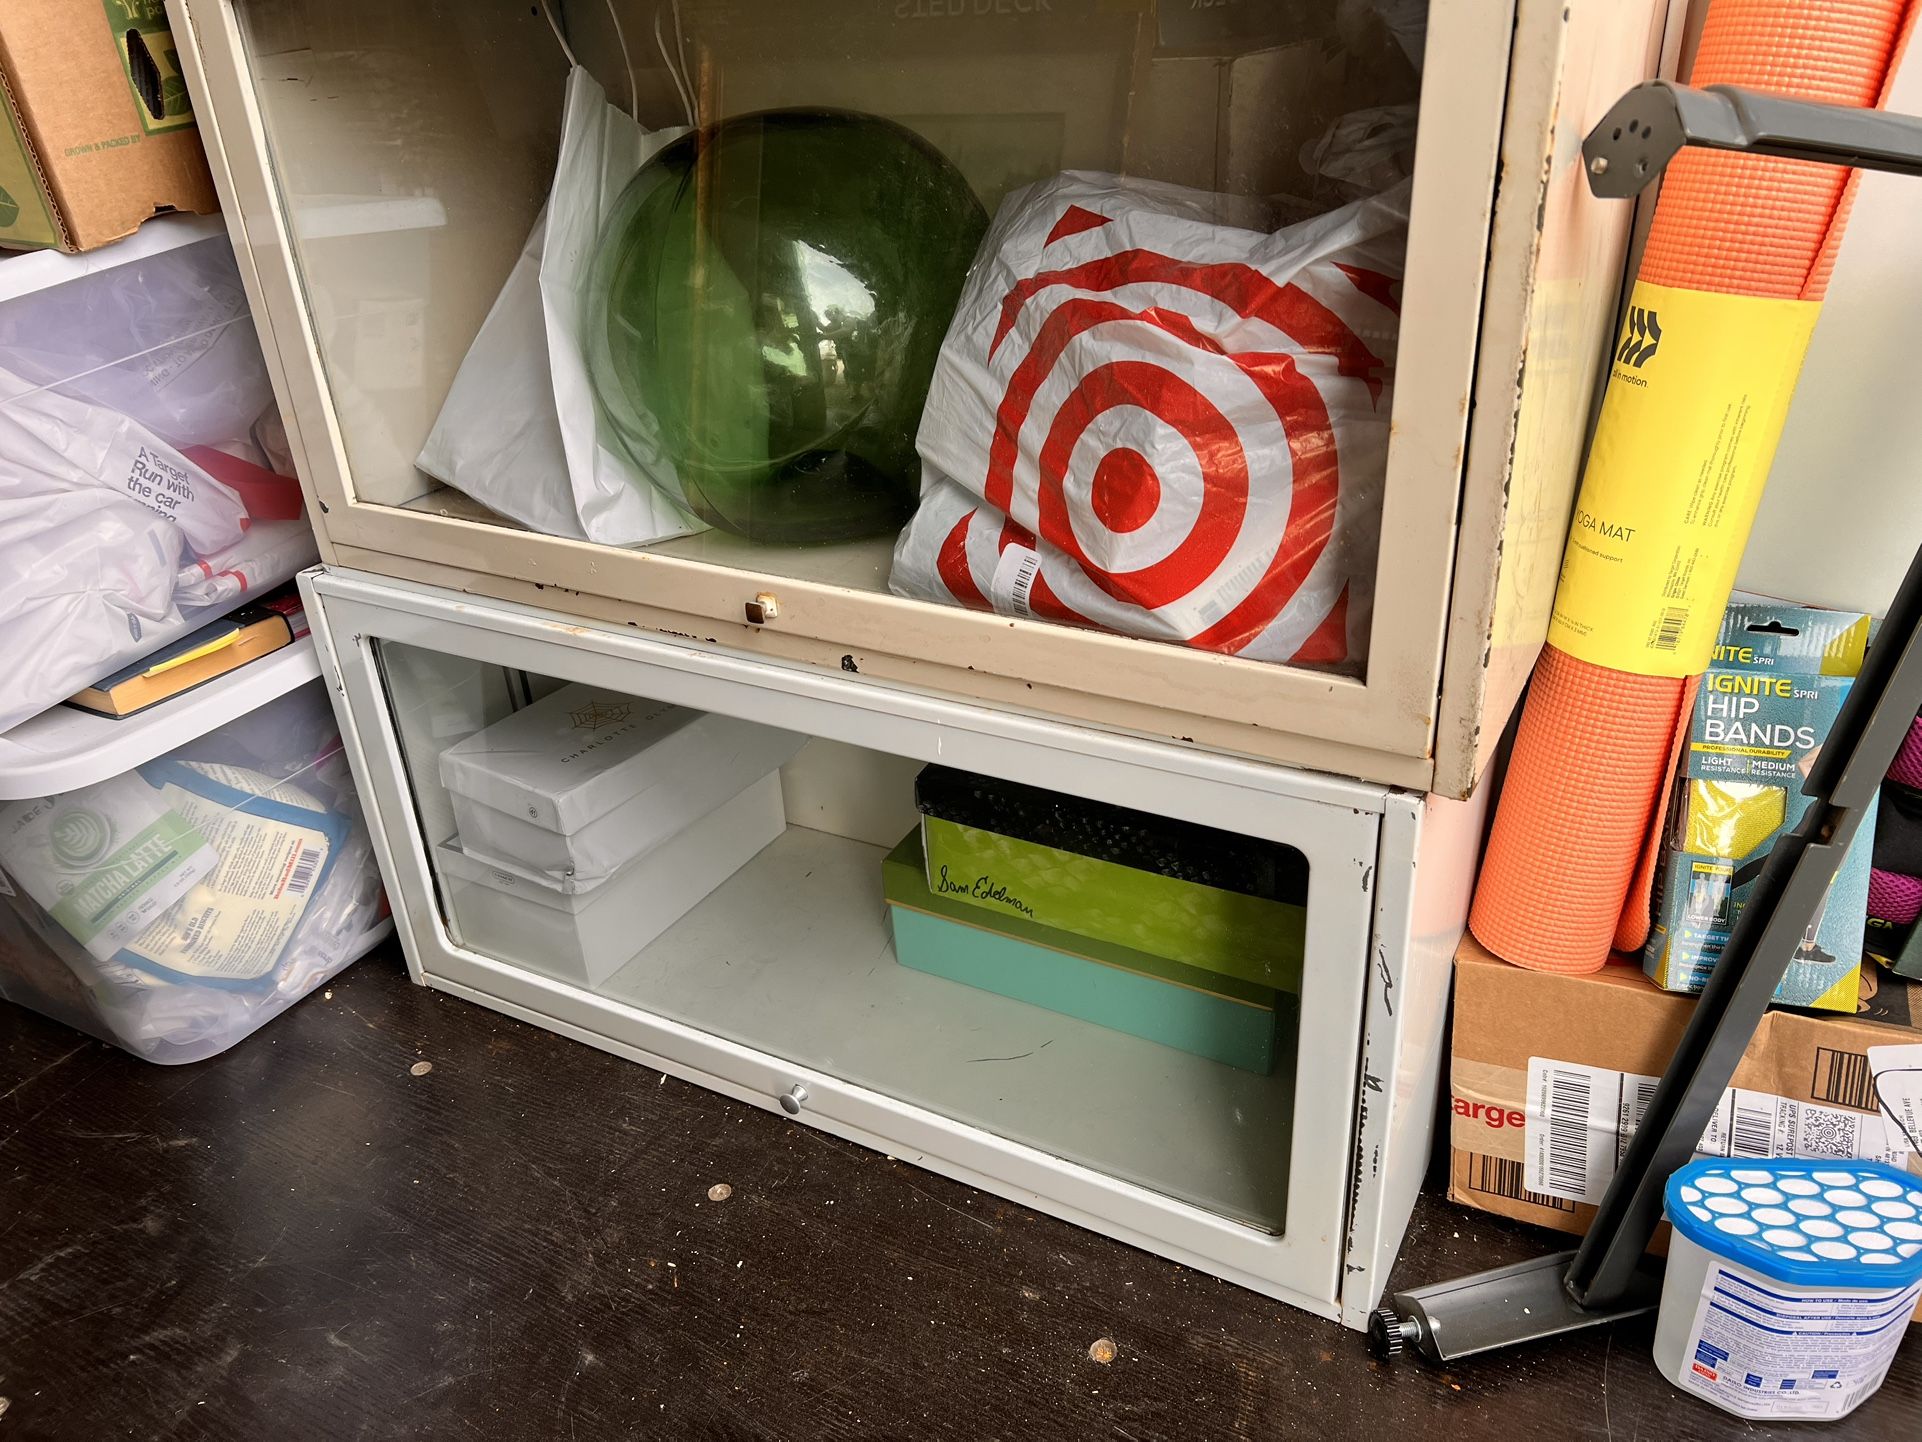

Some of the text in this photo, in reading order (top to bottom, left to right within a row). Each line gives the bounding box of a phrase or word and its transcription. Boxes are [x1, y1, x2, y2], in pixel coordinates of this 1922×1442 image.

[64, 145, 93, 157] GROWN
[102, 136, 130, 150] PACKED
[138, 446, 190, 485] A Target
[128, 475, 182, 510] the car
[131, 459, 195, 502] Run with
[1577, 509, 1636, 542] OGA MAT
[1600, 553, 1623, 563] support
[1712, 644, 1774, 666] NITE SPRI
[1706, 674, 1818, 700] IGNITE SPRI
[1706, 694, 1760, 718] HIP
[561, 724, 636, 763] CHARLOTTE
[1704, 720, 1815, 750] BANDS
[1702, 744, 1785, 756] PROFESSIONAL DURABILITY
[1702, 756, 1732, 766] LIGHT
[1700, 765, 1746, 774] RESISTANCE
[1752, 760, 1796, 772] MEDIUM
[1752, 770, 1796, 779] RESISTANCE
[74, 870, 130, 918] MATCHA
[124, 834, 172, 876] LATTE
[938, 864, 1033, 918] Sam Edelman
[1777, 1101, 1788, 1128] TRACKING
[1908, 1108, 1918, 1134] BELLEVUE
[1784, 1104, 1797, 1155] UPS SUREPOST
[1744, 1386, 1776, 1395] INDUSTRIES
